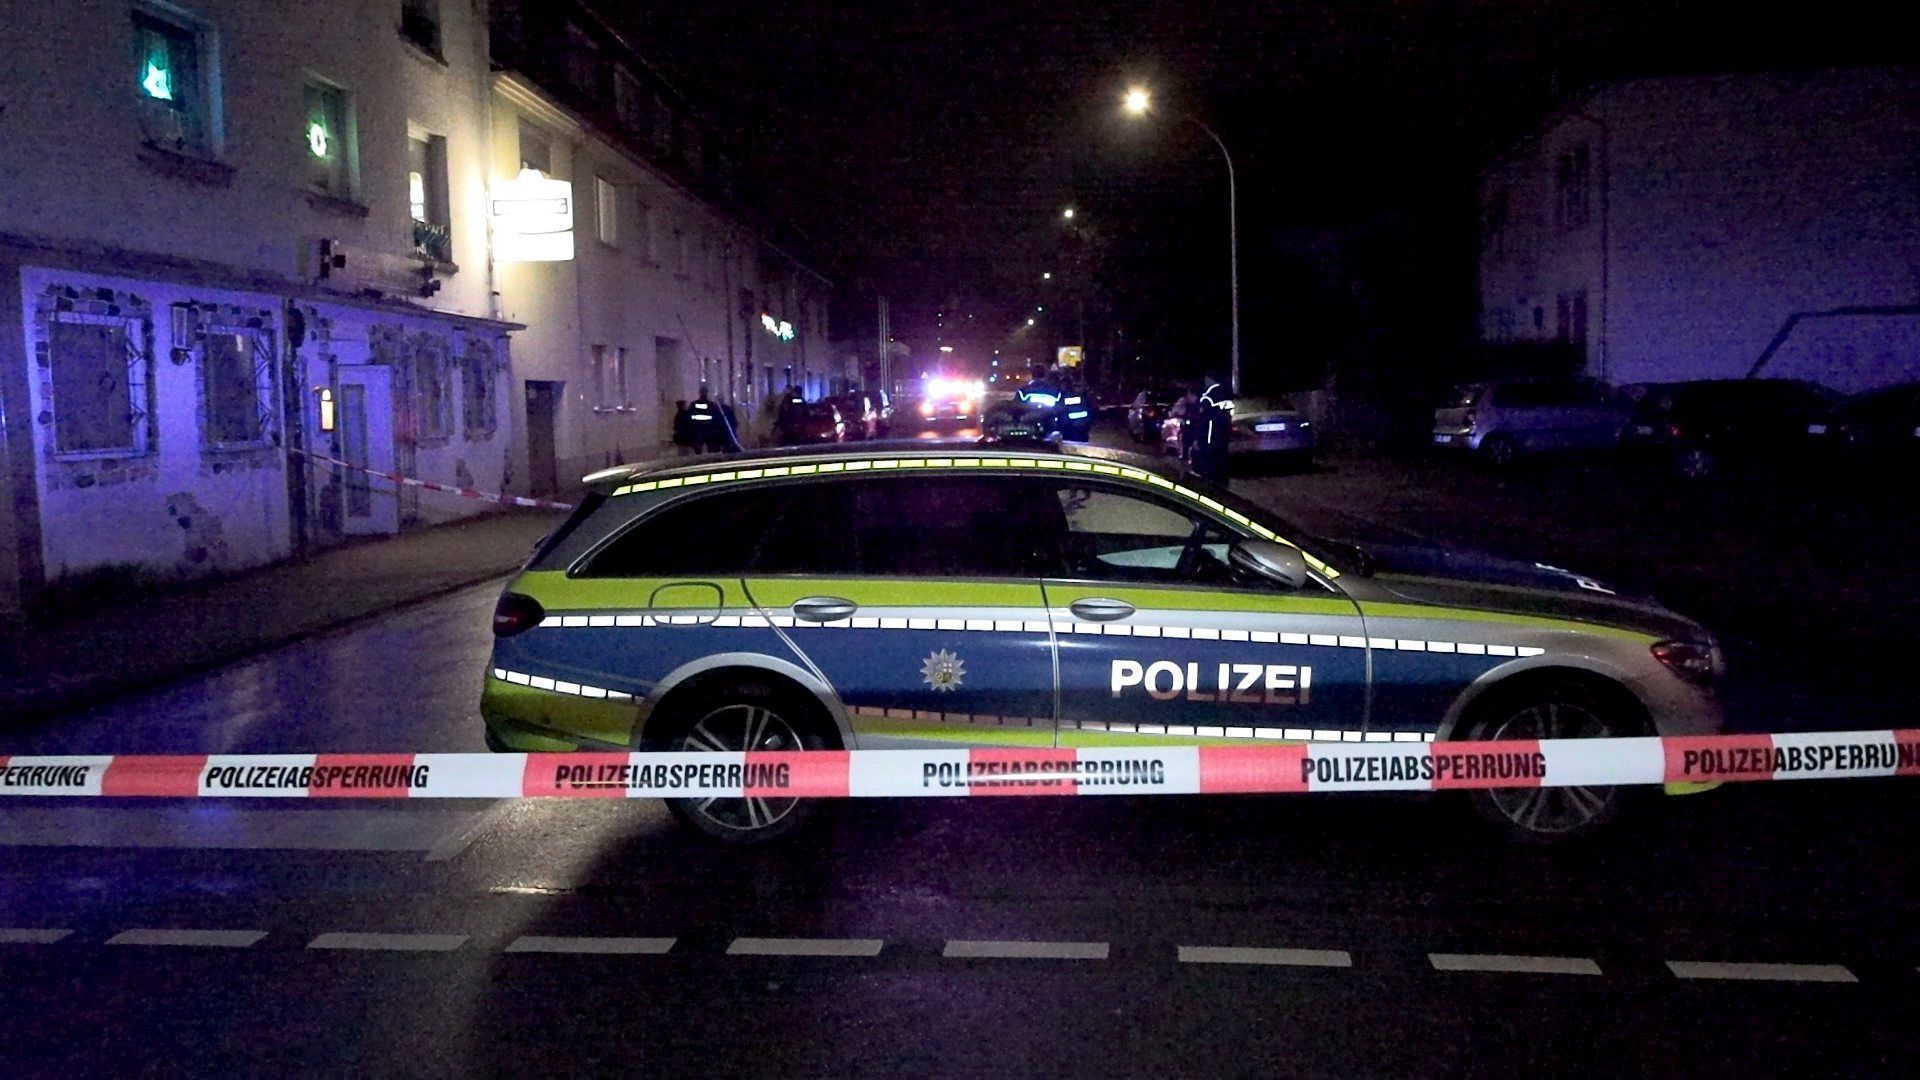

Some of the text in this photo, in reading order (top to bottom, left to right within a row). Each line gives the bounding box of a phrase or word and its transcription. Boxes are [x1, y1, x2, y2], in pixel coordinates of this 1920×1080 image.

[1111, 659, 1312, 705] POLIZEI
[206, 764, 430, 788] POLIZEIABSPERRUNG
[555, 763, 790, 789] POLIZEIABSPERRUNG
[923, 759, 1165, 788] POLIZEIABSPERRUNG
[1301, 752, 1546, 784] POLIZEIABSPERRUNG
